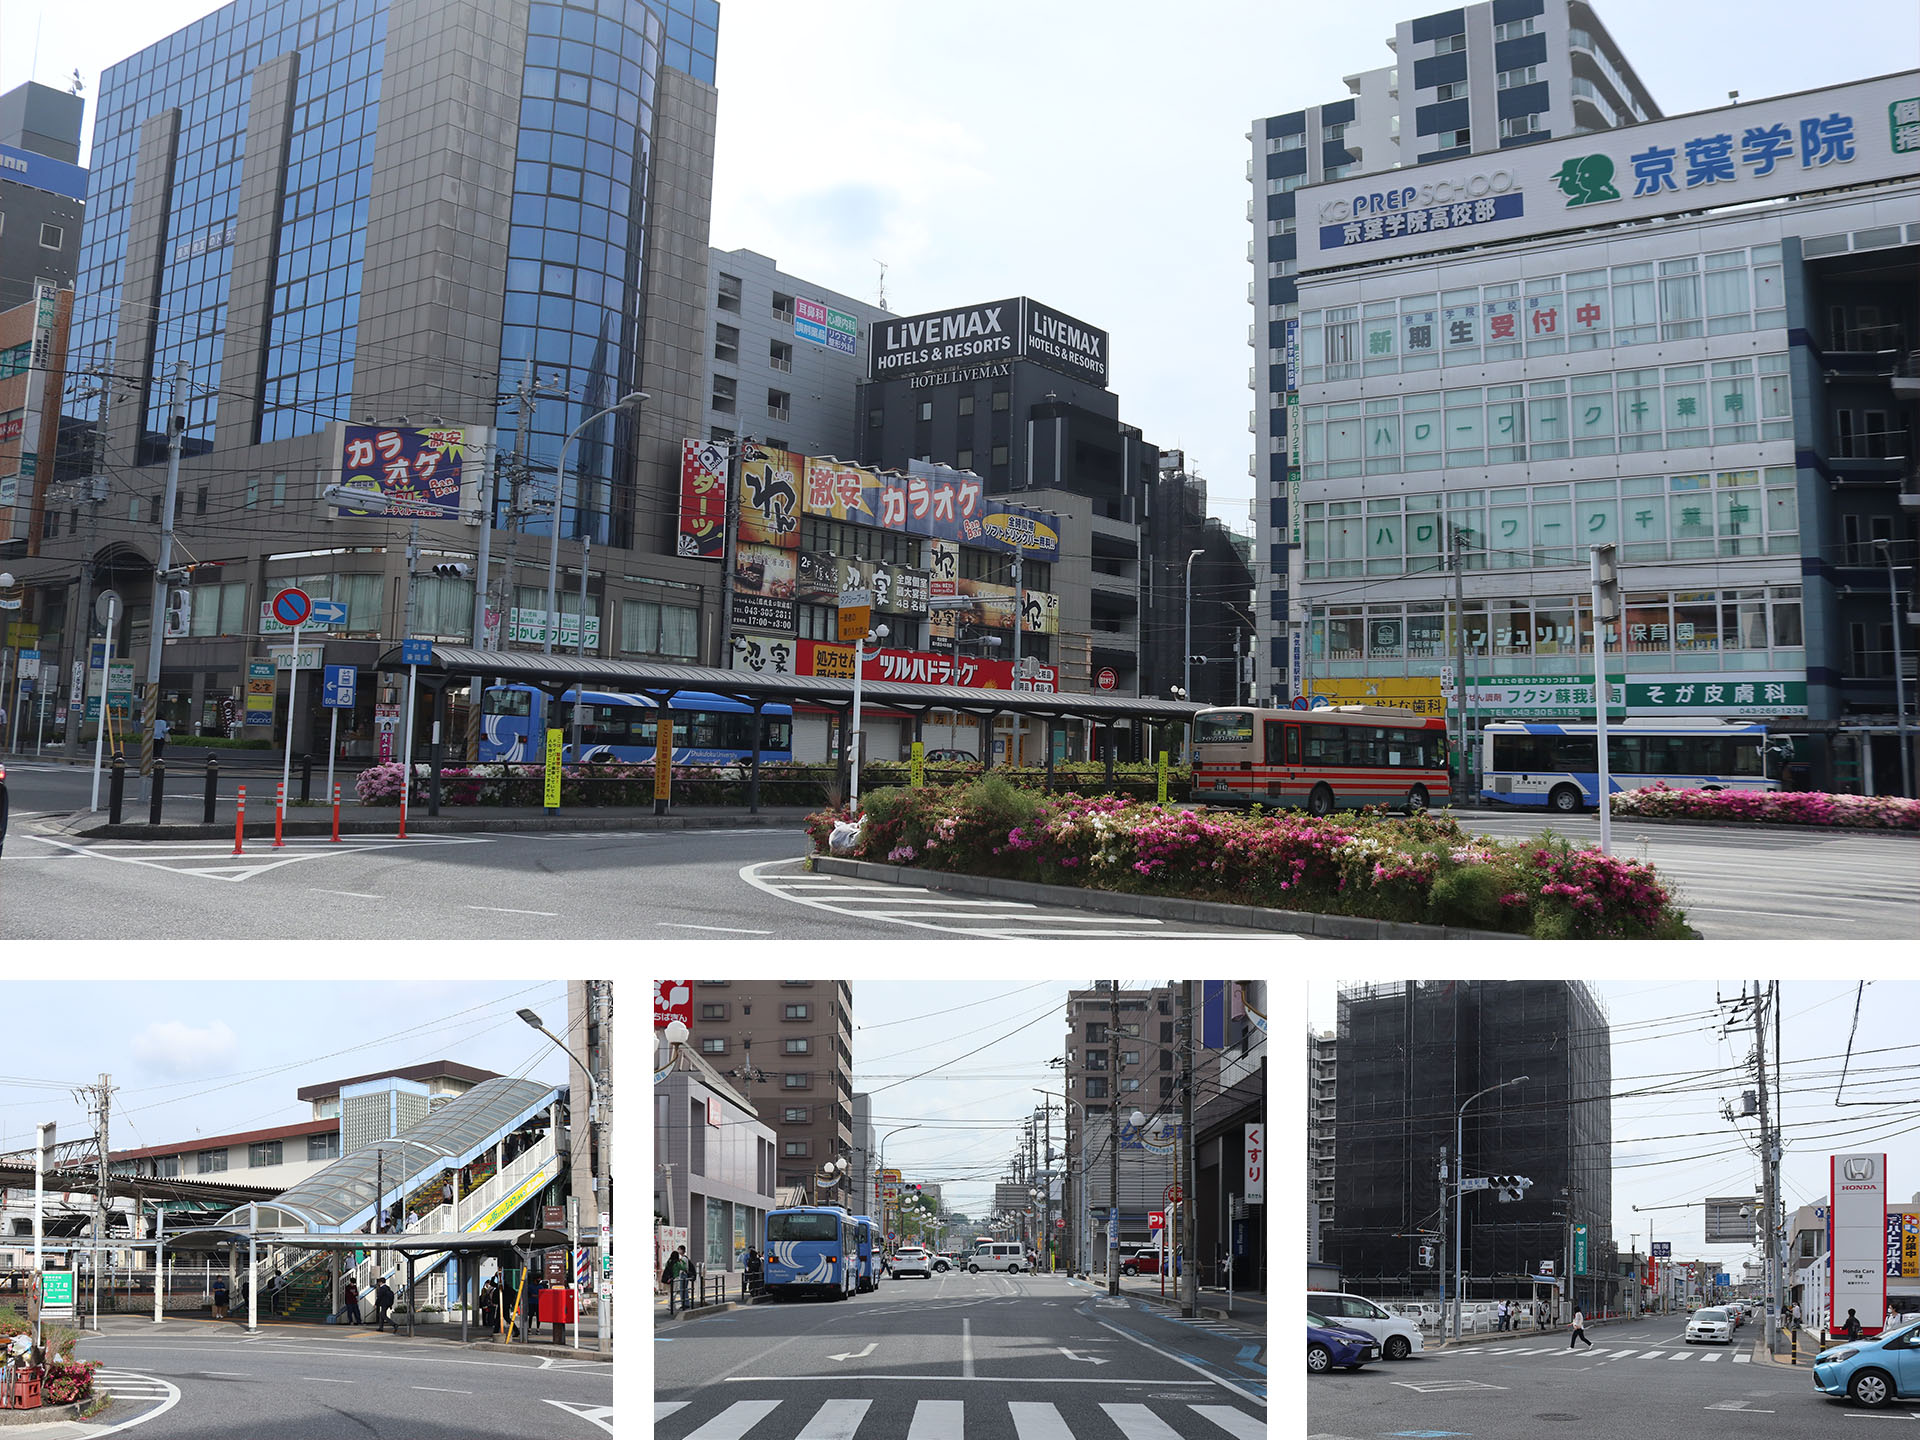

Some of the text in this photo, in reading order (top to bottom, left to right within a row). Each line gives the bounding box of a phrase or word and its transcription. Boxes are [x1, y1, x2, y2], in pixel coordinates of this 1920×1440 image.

[1630, 112, 1856, 197] 京葉学院
[1353, 187, 1417, 218] PREP
[1418, 168, 1523, 206] SCHOOL
[1342, 199, 1496, 245] 京葉学院高校部
[799, 303, 825, 322] 耳鼻科
[886, 307, 1002, 350] LiVEMAX
[1369, 303, 1601, 354] 新期生受付中
[829, 330, 854, 343] リウマチ
[878, 335, 1011, 370] HOTELS & RESORTS
[1029, 335, 1105, 375] HOTELS & RESORTS
[1034, 312, 1100, 358] LiVEMAX
[910, 364, 1010, 389] HOTEL LiVEMAX
[1375, 392, 1744, 445] ハローワーク千葉南
[346, 431, 441, 486] カラオケ
[428, 430, 462, 448] 激安
[692, 474, 716, 537] ダーツ
[745, 464, 796, 535] わん
[808, 467, 862, 508] 激安
[881, 478, 980, 528] カラオケ
[1376, 505, 1749, 545] ハローワーク千葉南
[801, 556, 811, 568] 2F
[896, 574, 928, 588] 全席個室
[1047, 596, 1057, 608] 2F
[585, 620, 597, 631] 2F
[1646, 684, 1787, 704] そが皮膚科
[1248, 1130, 1262, 1182] くすり
[1149, 1216, 1158, 1226] P
